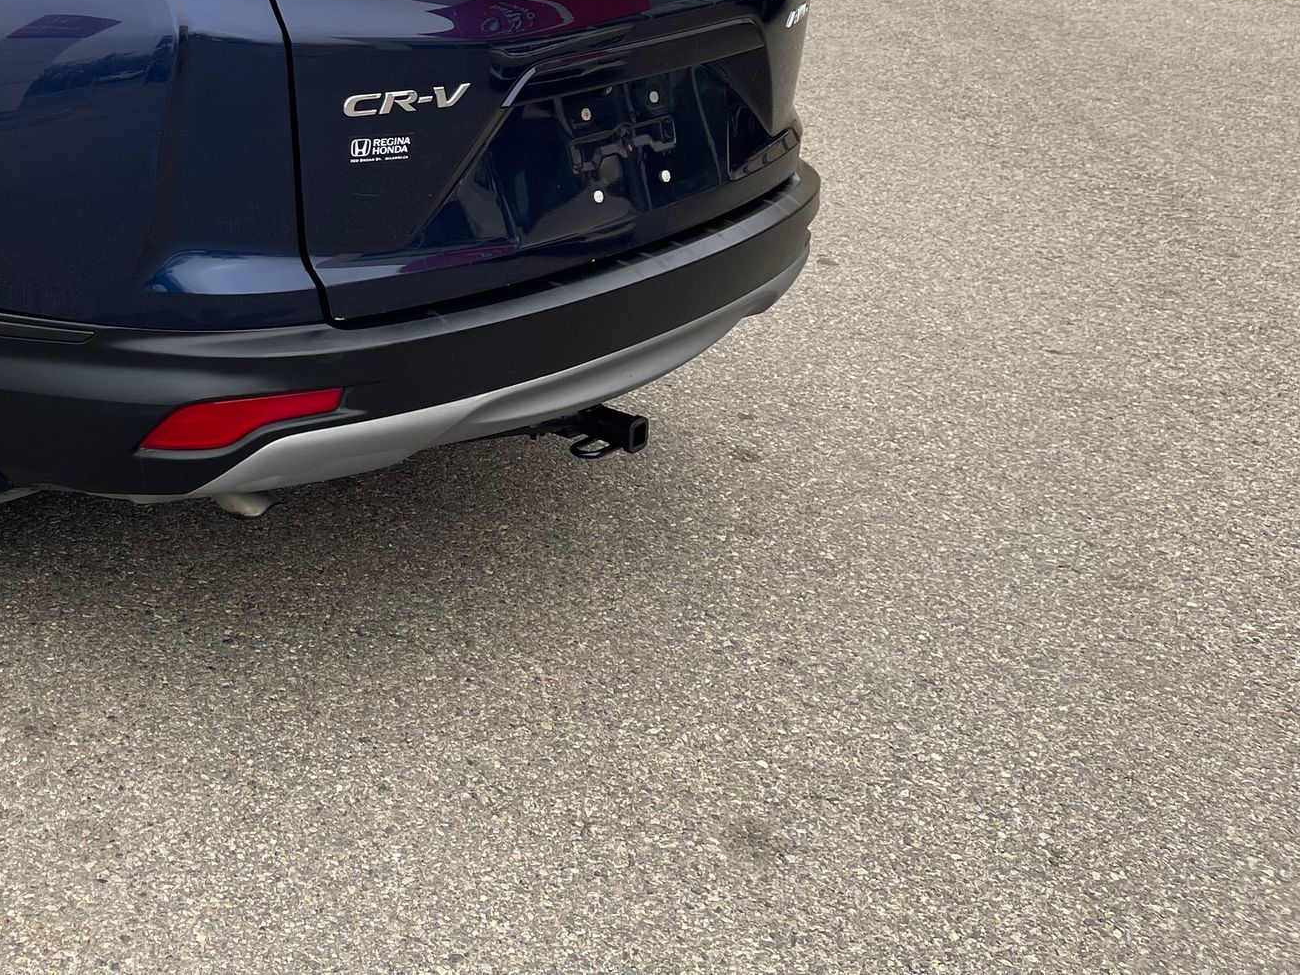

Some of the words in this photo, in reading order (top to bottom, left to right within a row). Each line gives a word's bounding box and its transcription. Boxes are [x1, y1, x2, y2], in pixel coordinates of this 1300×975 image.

[343, 82, 471, 117] CR-V
[373, 137, 411, 146] REGINA
[372, 145, 408, 155] HONDA
